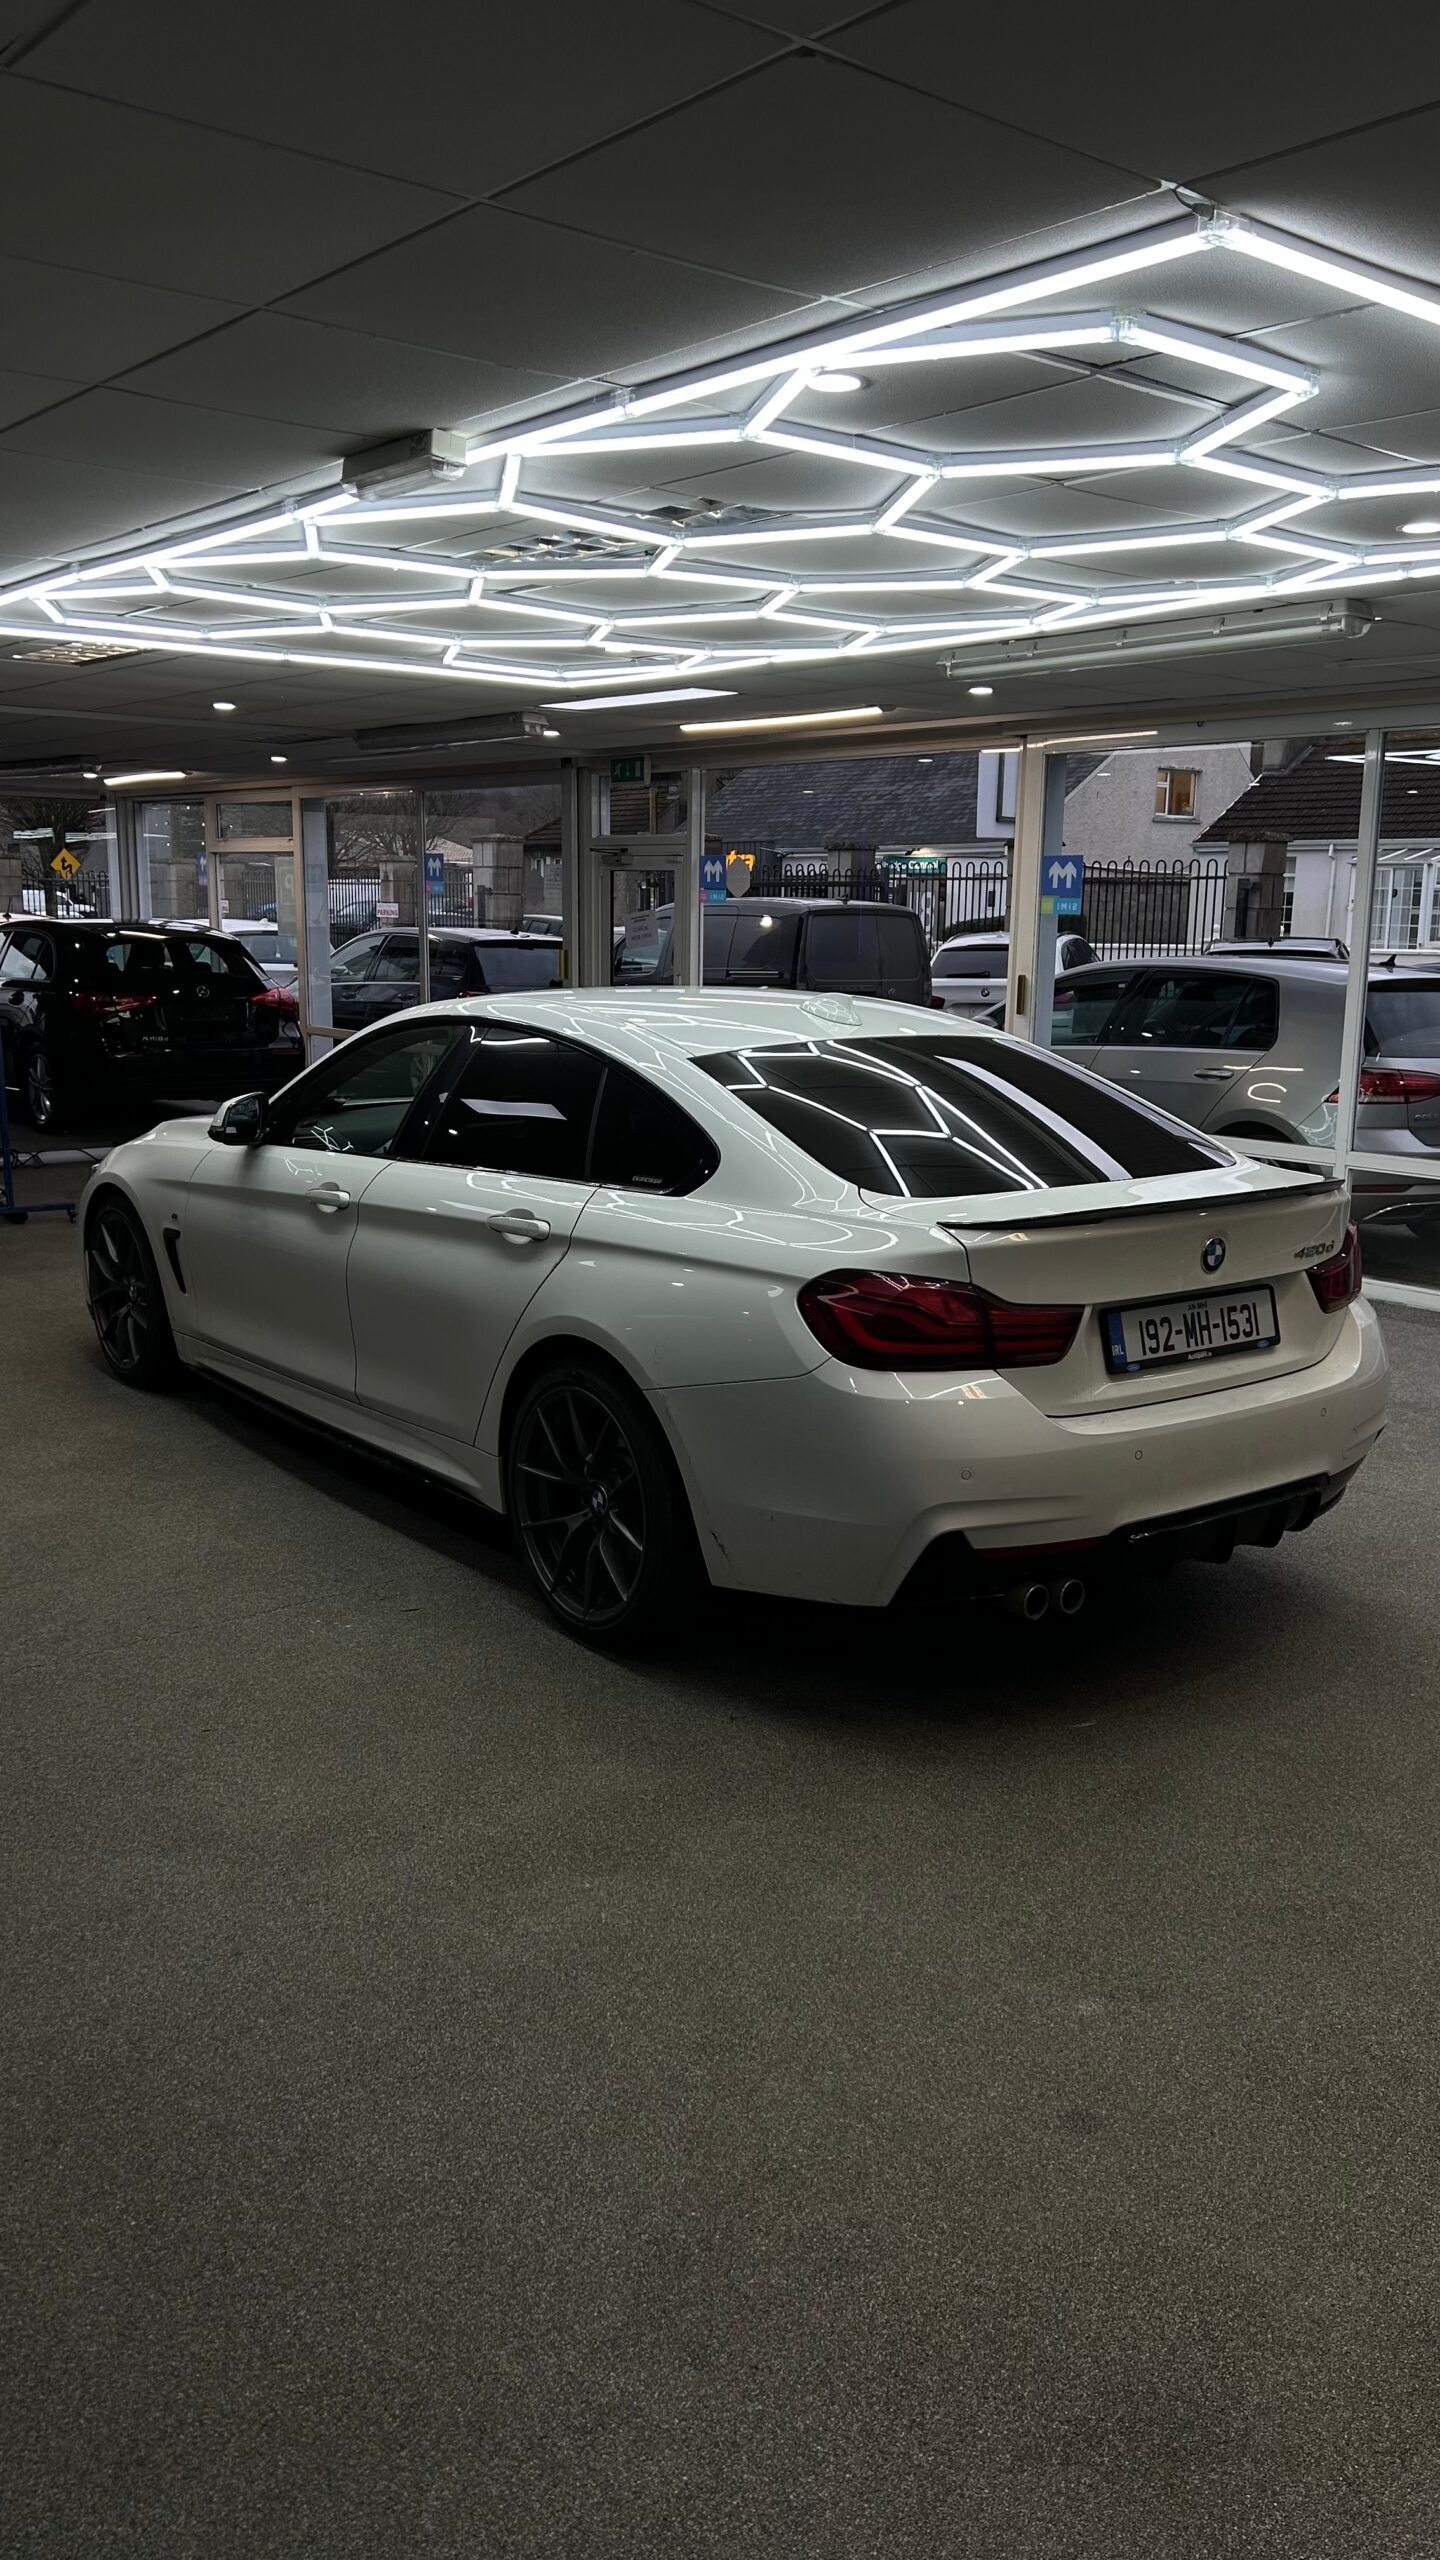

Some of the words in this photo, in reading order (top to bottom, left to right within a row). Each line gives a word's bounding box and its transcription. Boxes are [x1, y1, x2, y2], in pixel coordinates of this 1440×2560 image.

[1294, 1240, 1335, 1259] 420d
[1138, 1302, 1261, 1357] 192-MH-1531
[1111, 1343, 1125, 1357] IRL
